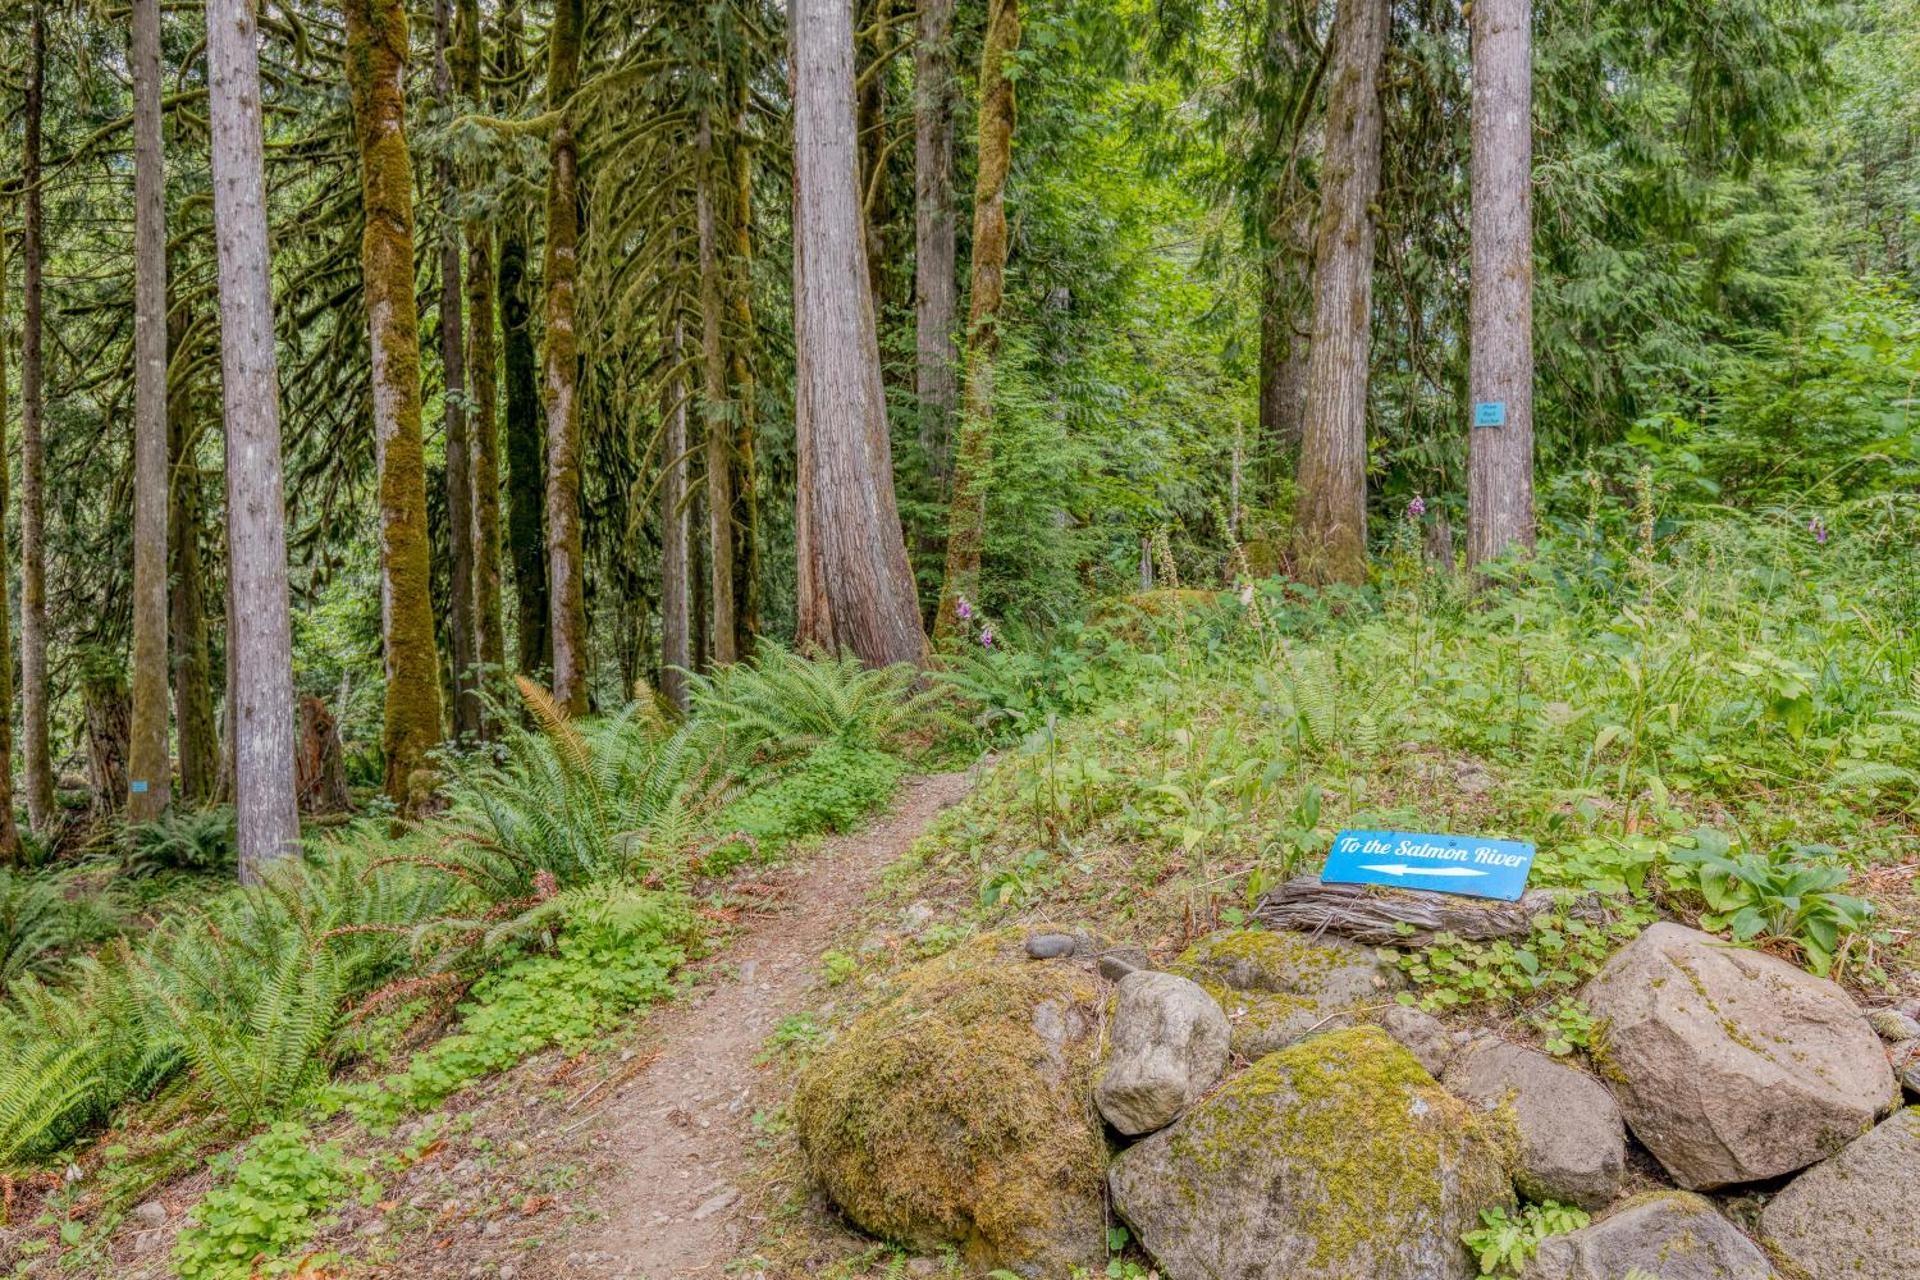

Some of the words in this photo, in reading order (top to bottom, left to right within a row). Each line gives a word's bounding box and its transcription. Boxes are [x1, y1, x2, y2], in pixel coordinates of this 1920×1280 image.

[1340, 837, 1362, 853] To
[1362, 840, 1391, 855] the
[1394, 840, 1468, 862] Salmon
[1474, 847, 1527, 868] River
